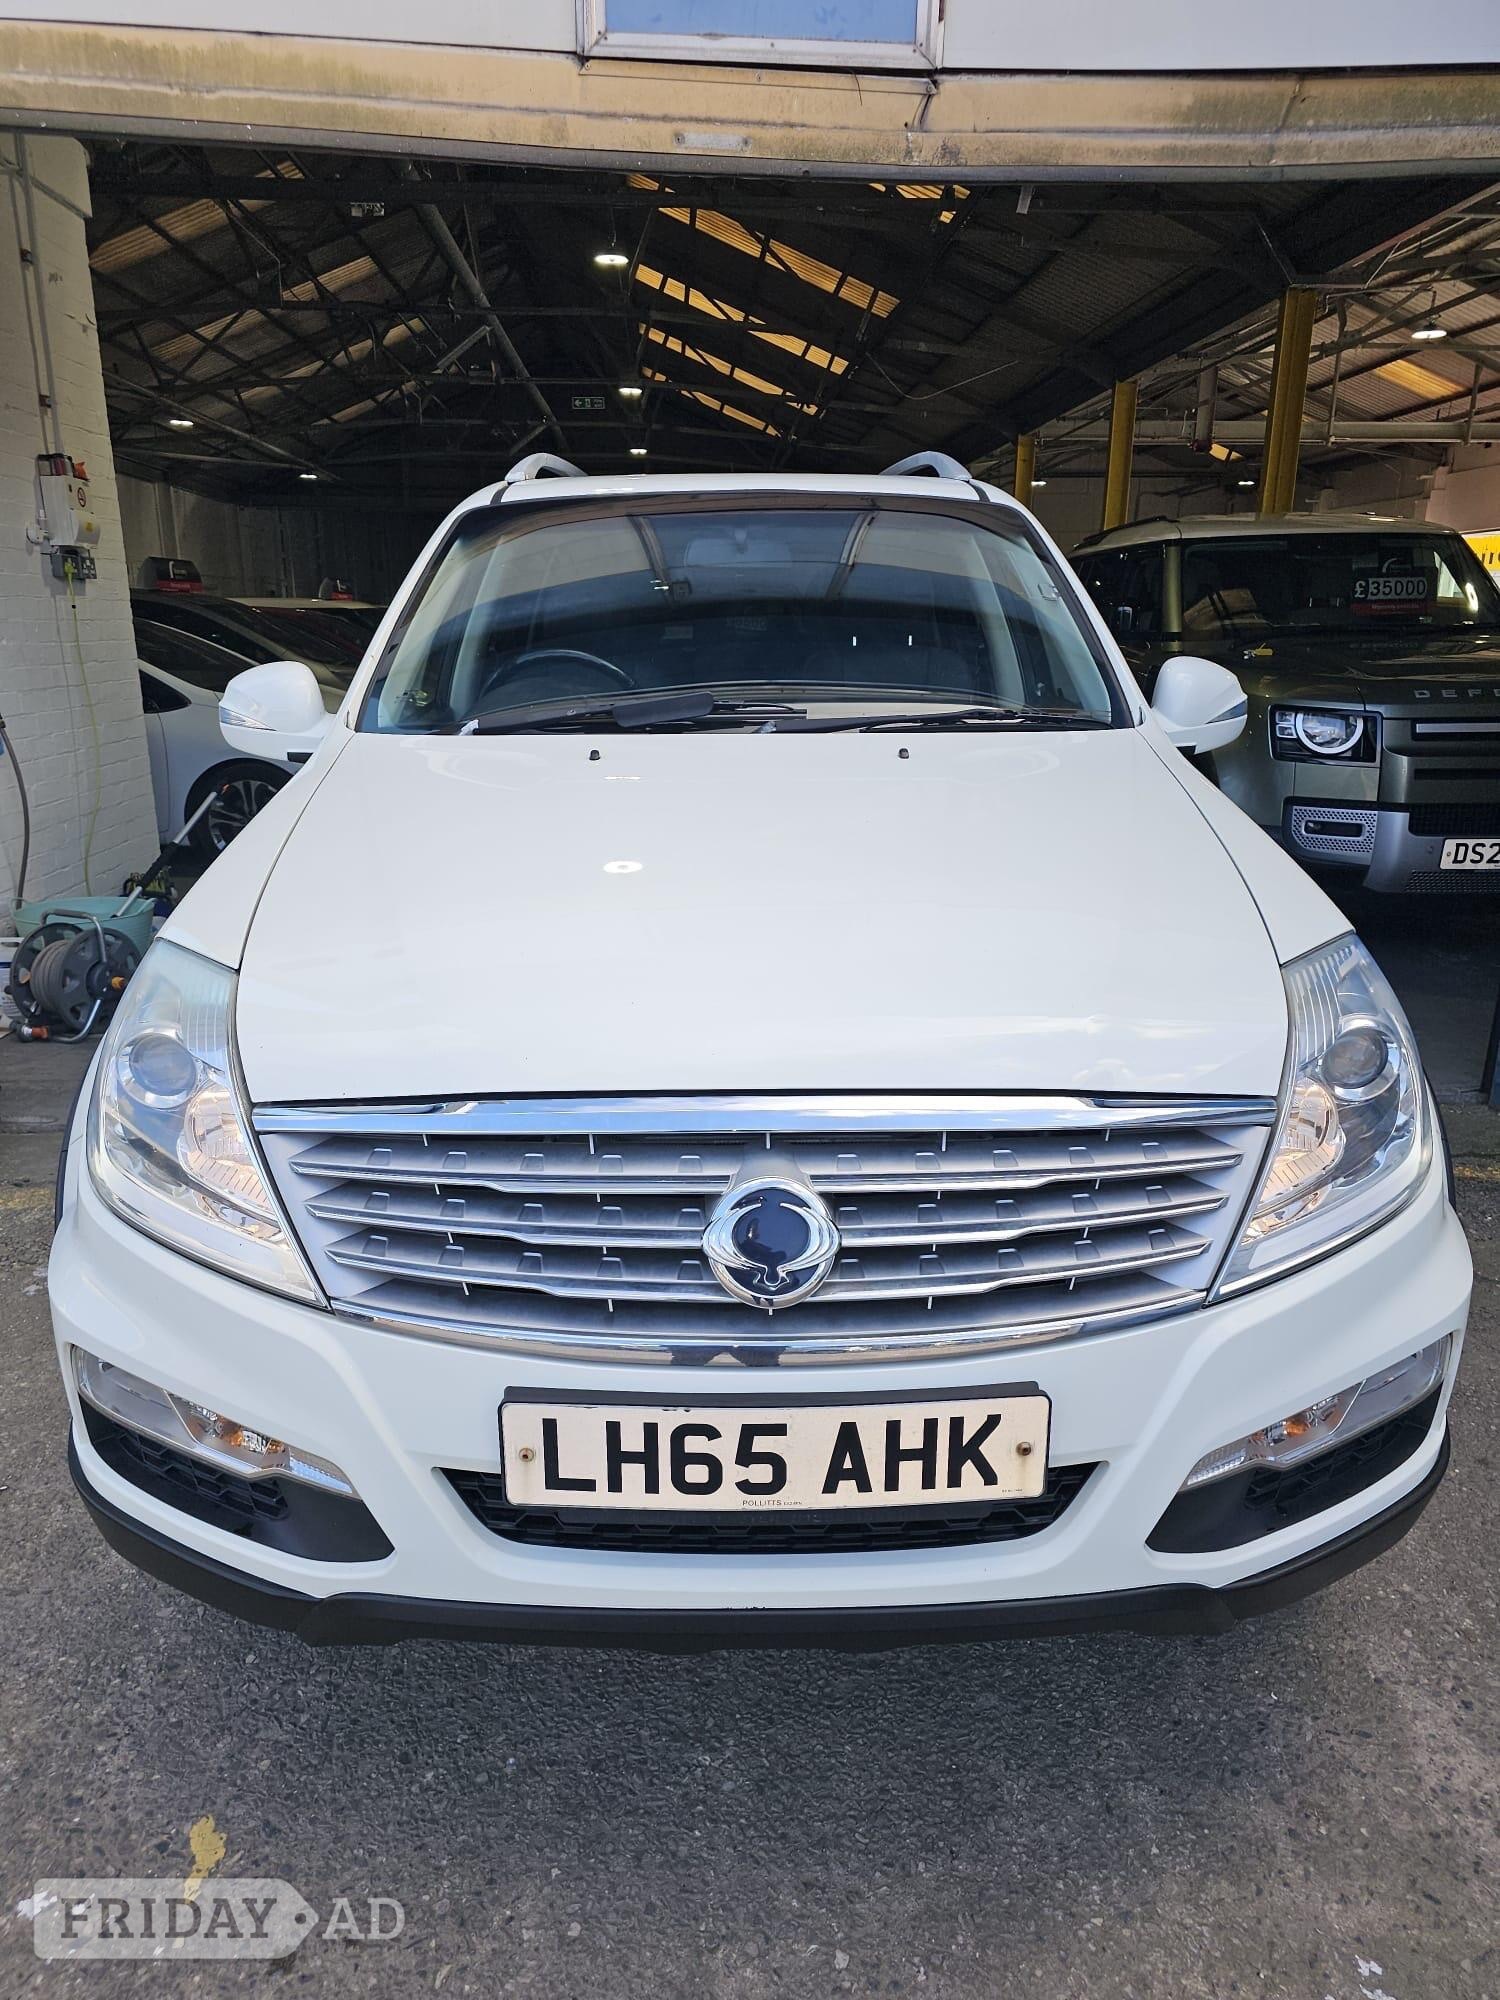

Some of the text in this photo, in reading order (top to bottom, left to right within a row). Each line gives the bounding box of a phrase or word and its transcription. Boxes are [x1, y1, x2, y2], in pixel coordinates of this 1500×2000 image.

[1354, 580, 1427, 598] £35000
[1452, 842, 1500, 864] DS2
[543, 1414, 1001, 1495] LH65 AHK
